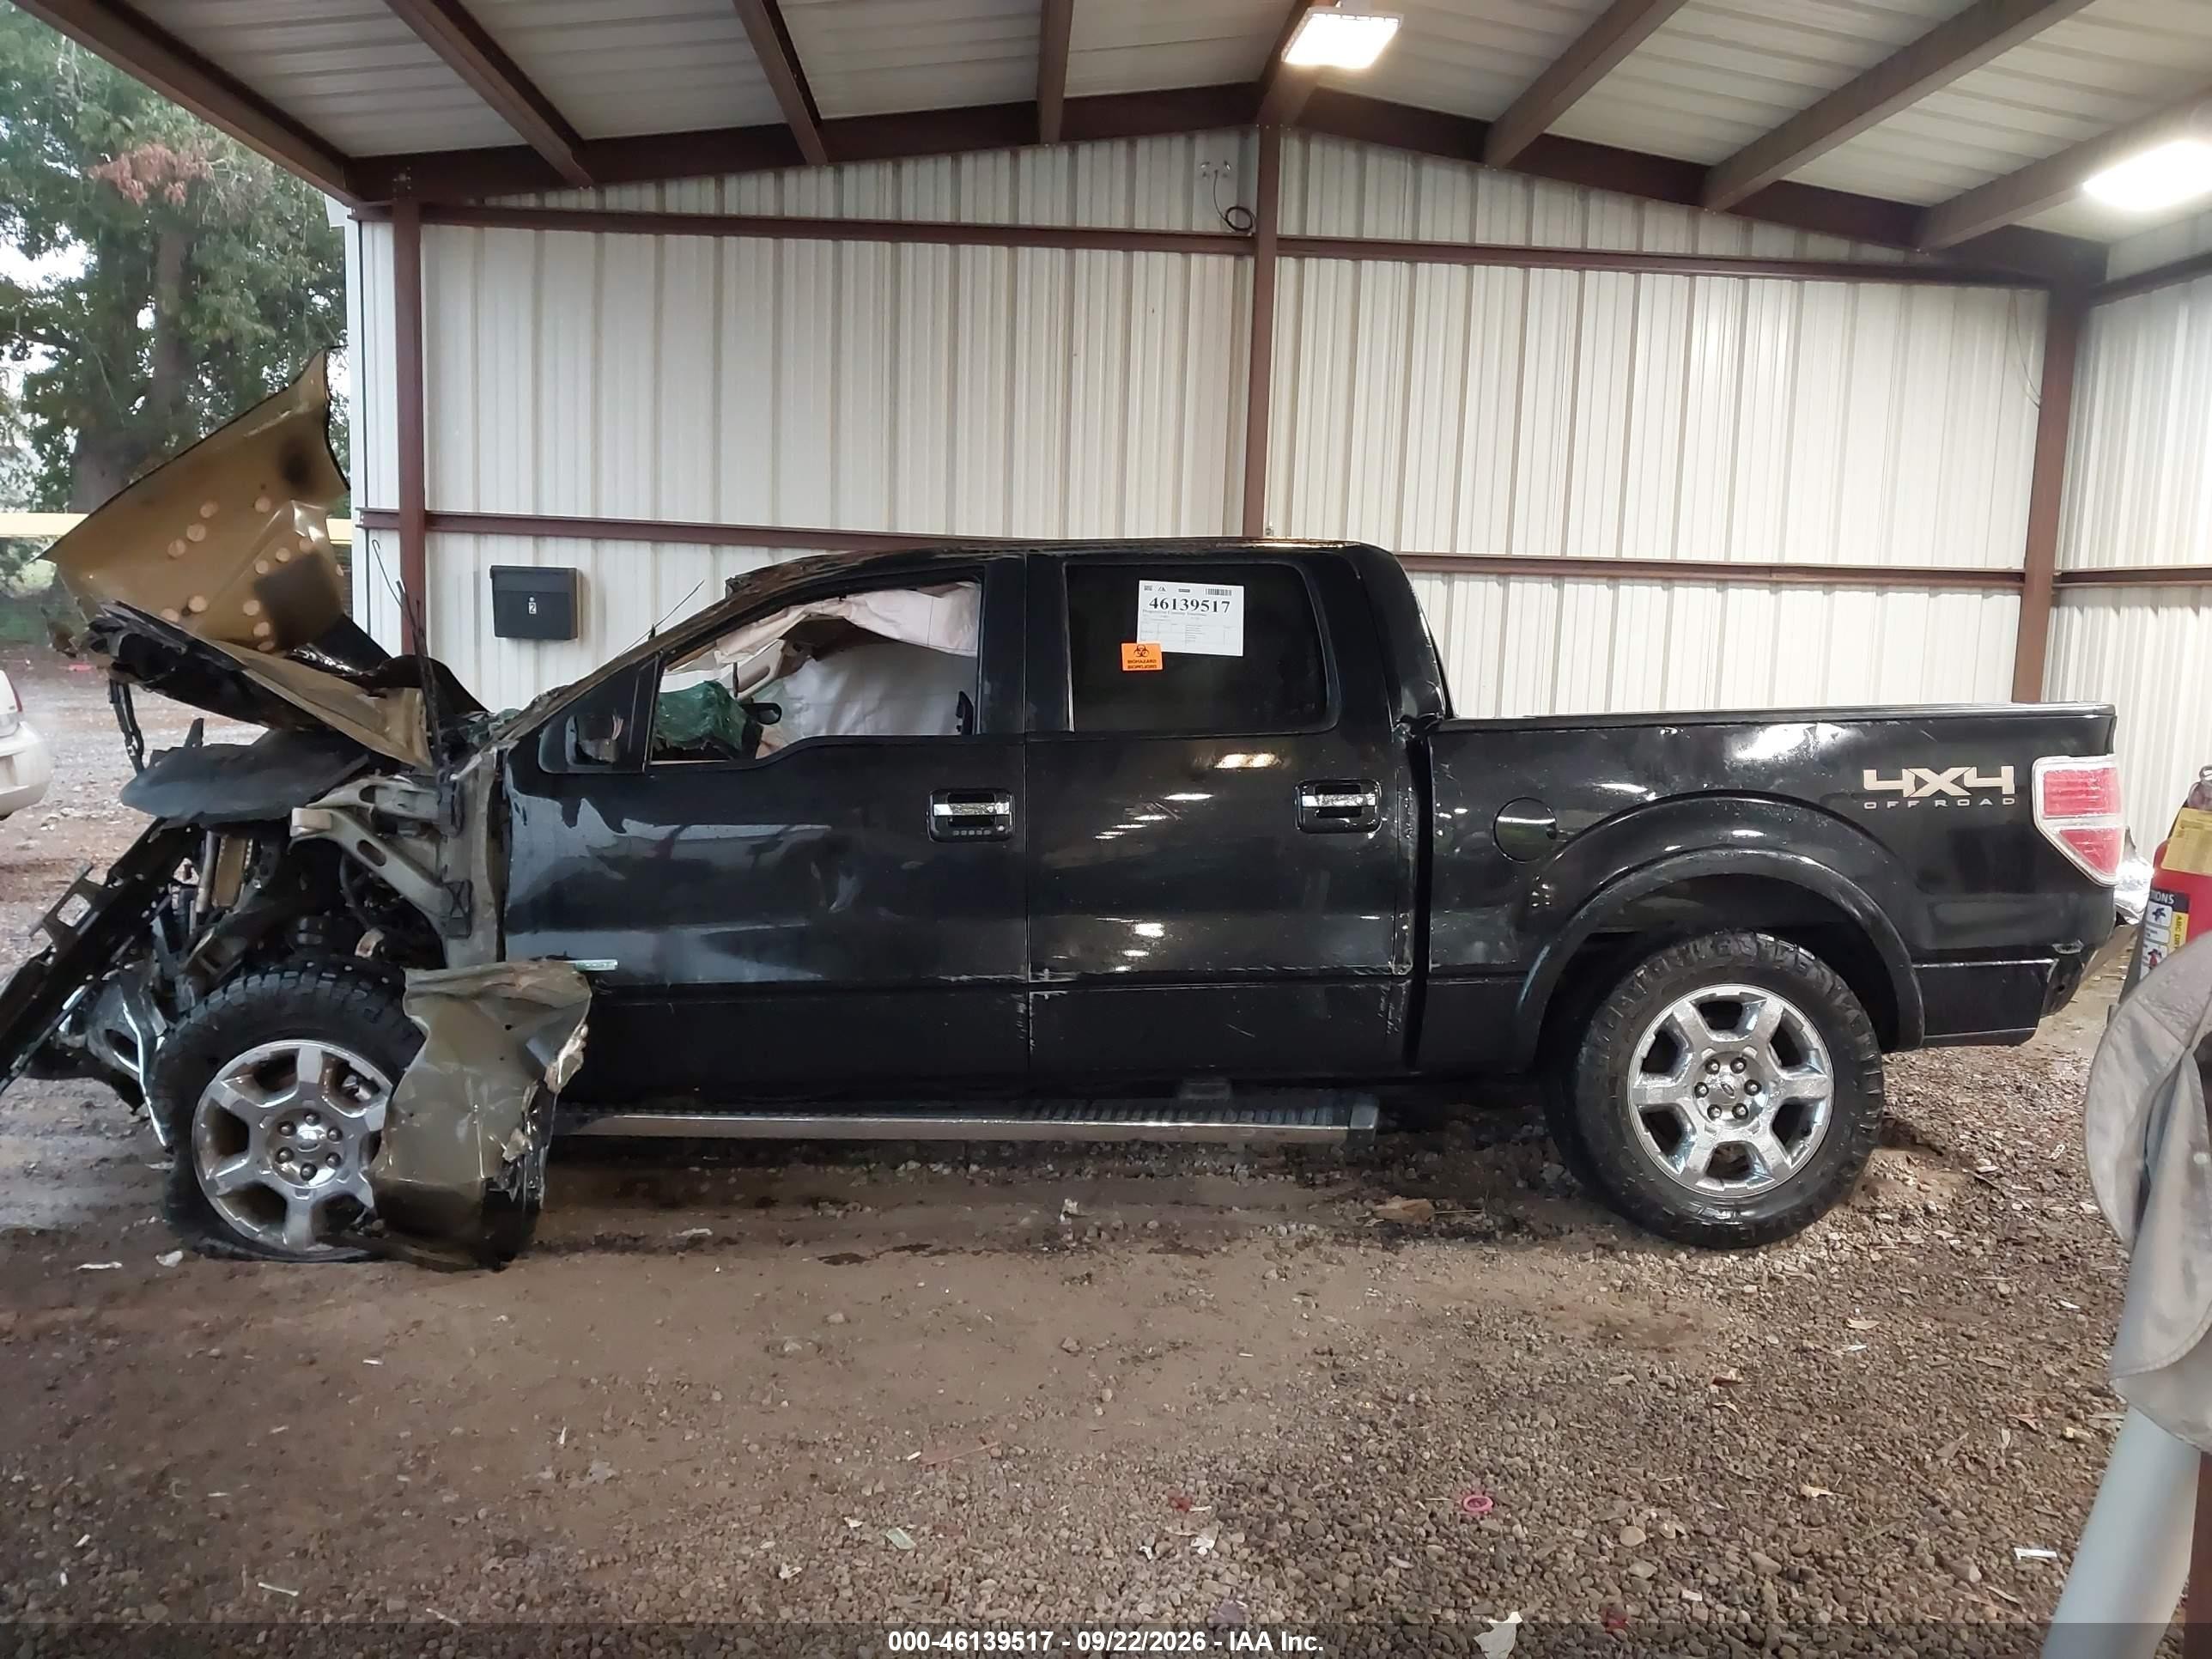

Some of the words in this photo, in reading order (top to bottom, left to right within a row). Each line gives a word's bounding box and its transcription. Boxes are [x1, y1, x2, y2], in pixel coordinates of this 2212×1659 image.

[530, 603, 536, 613] 2
[1149, 597, 1231, 613] 46139517
[1863, 766, 2015, 797] 4X4
[1863, 800, 1920, 810] OFF
[1935, 798, 2015, 808] ROAD
